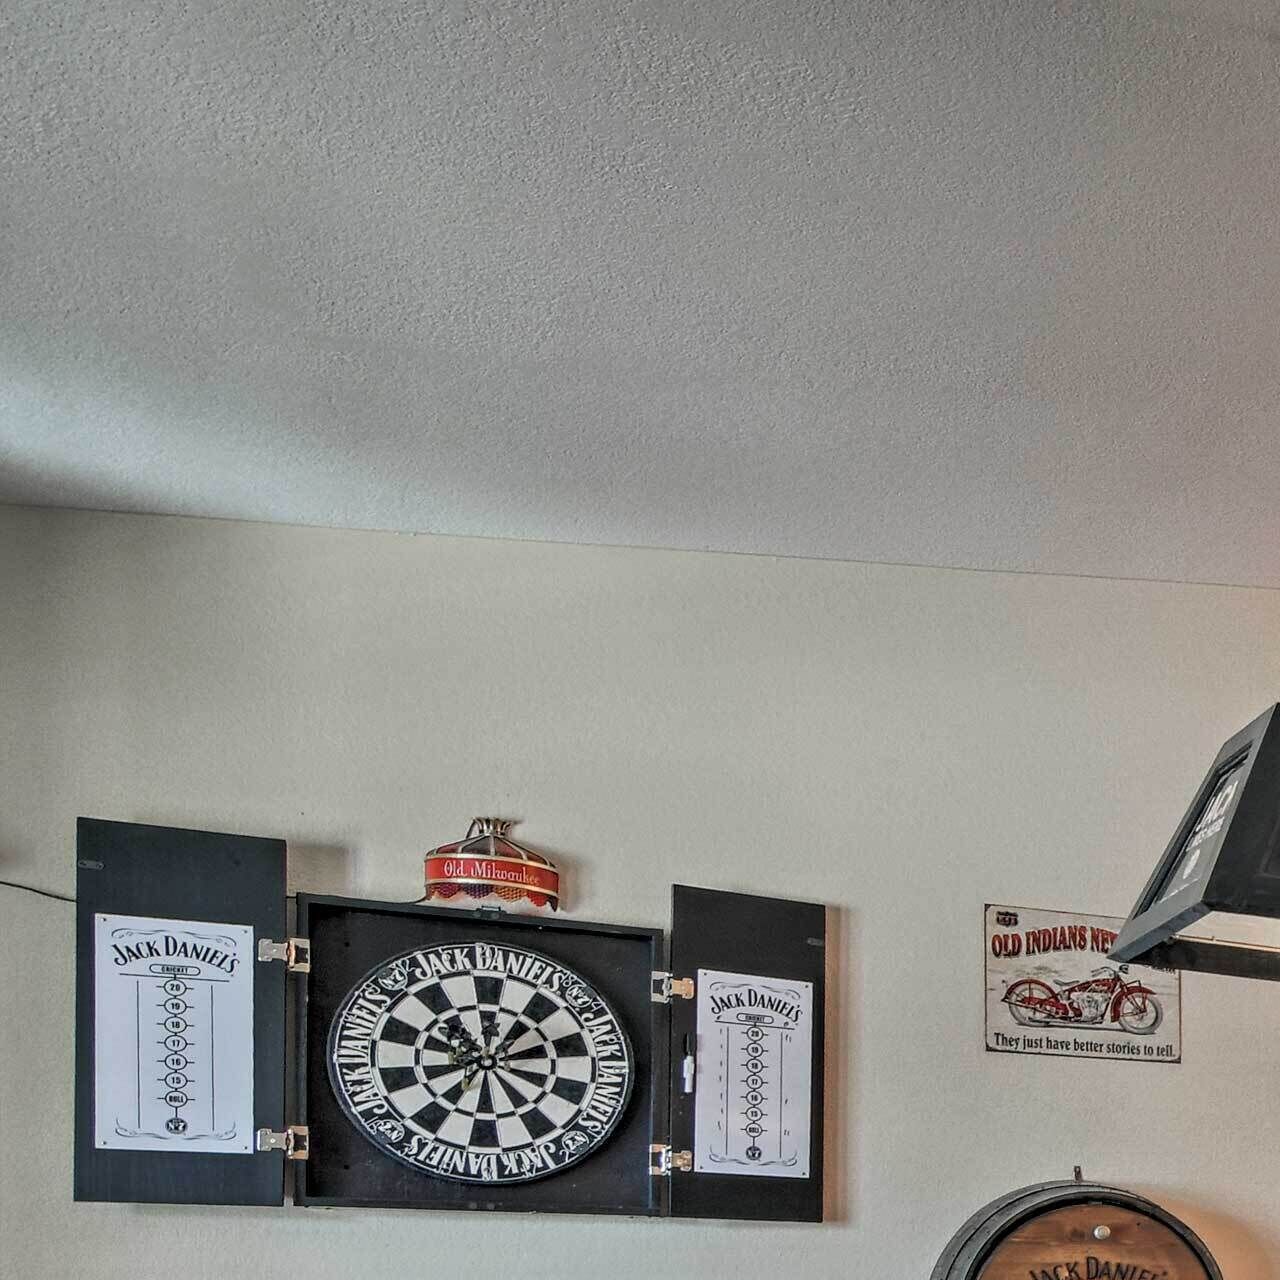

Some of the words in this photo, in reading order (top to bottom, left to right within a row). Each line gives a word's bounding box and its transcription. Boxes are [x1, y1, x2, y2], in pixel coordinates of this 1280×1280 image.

[444, 860, 467, 878] Old
[471, 861, 540, 886] Milwaukee
[991, 933, 1022, 957] OLD
[1025, 925, 1087, 955] INDIANS
[112, 939, 161, 967] JACK
[164, 935, 241, 976] DANIEL'S
[415, 948, 473, 980] JACK
[170, 983, 181, 991] 20
[171, 1002, 181, 1010] 19
[709, 993, 747, 1015] JACK
[748, 988, 803, 1023] DANIEL'S
[171, 1021, 181, 1029] 18
[171, 1039, 181, 1047] 17
[994, 1032, 1020, 1050] They
[1022, 1034, 1043, 1050] just
[1046, 1036, 1071, 1050] have
[1074, 1038, 1104, 1053] better
[1107, 1041, 1141, 1056] stories
[1143, 1044, 1154, 1056] to
[1156, 1045, 1176, 1057] tell.
[751, 1046, 759, 1054] 19
[171, 1058, 181, 1066] 16
[751, 1062, 759, 1070] 18
[171, 1076, 182, 1084] 15
[751, 1078, 758, 1086] 17
[750, 1094, 759, 1102] 16
